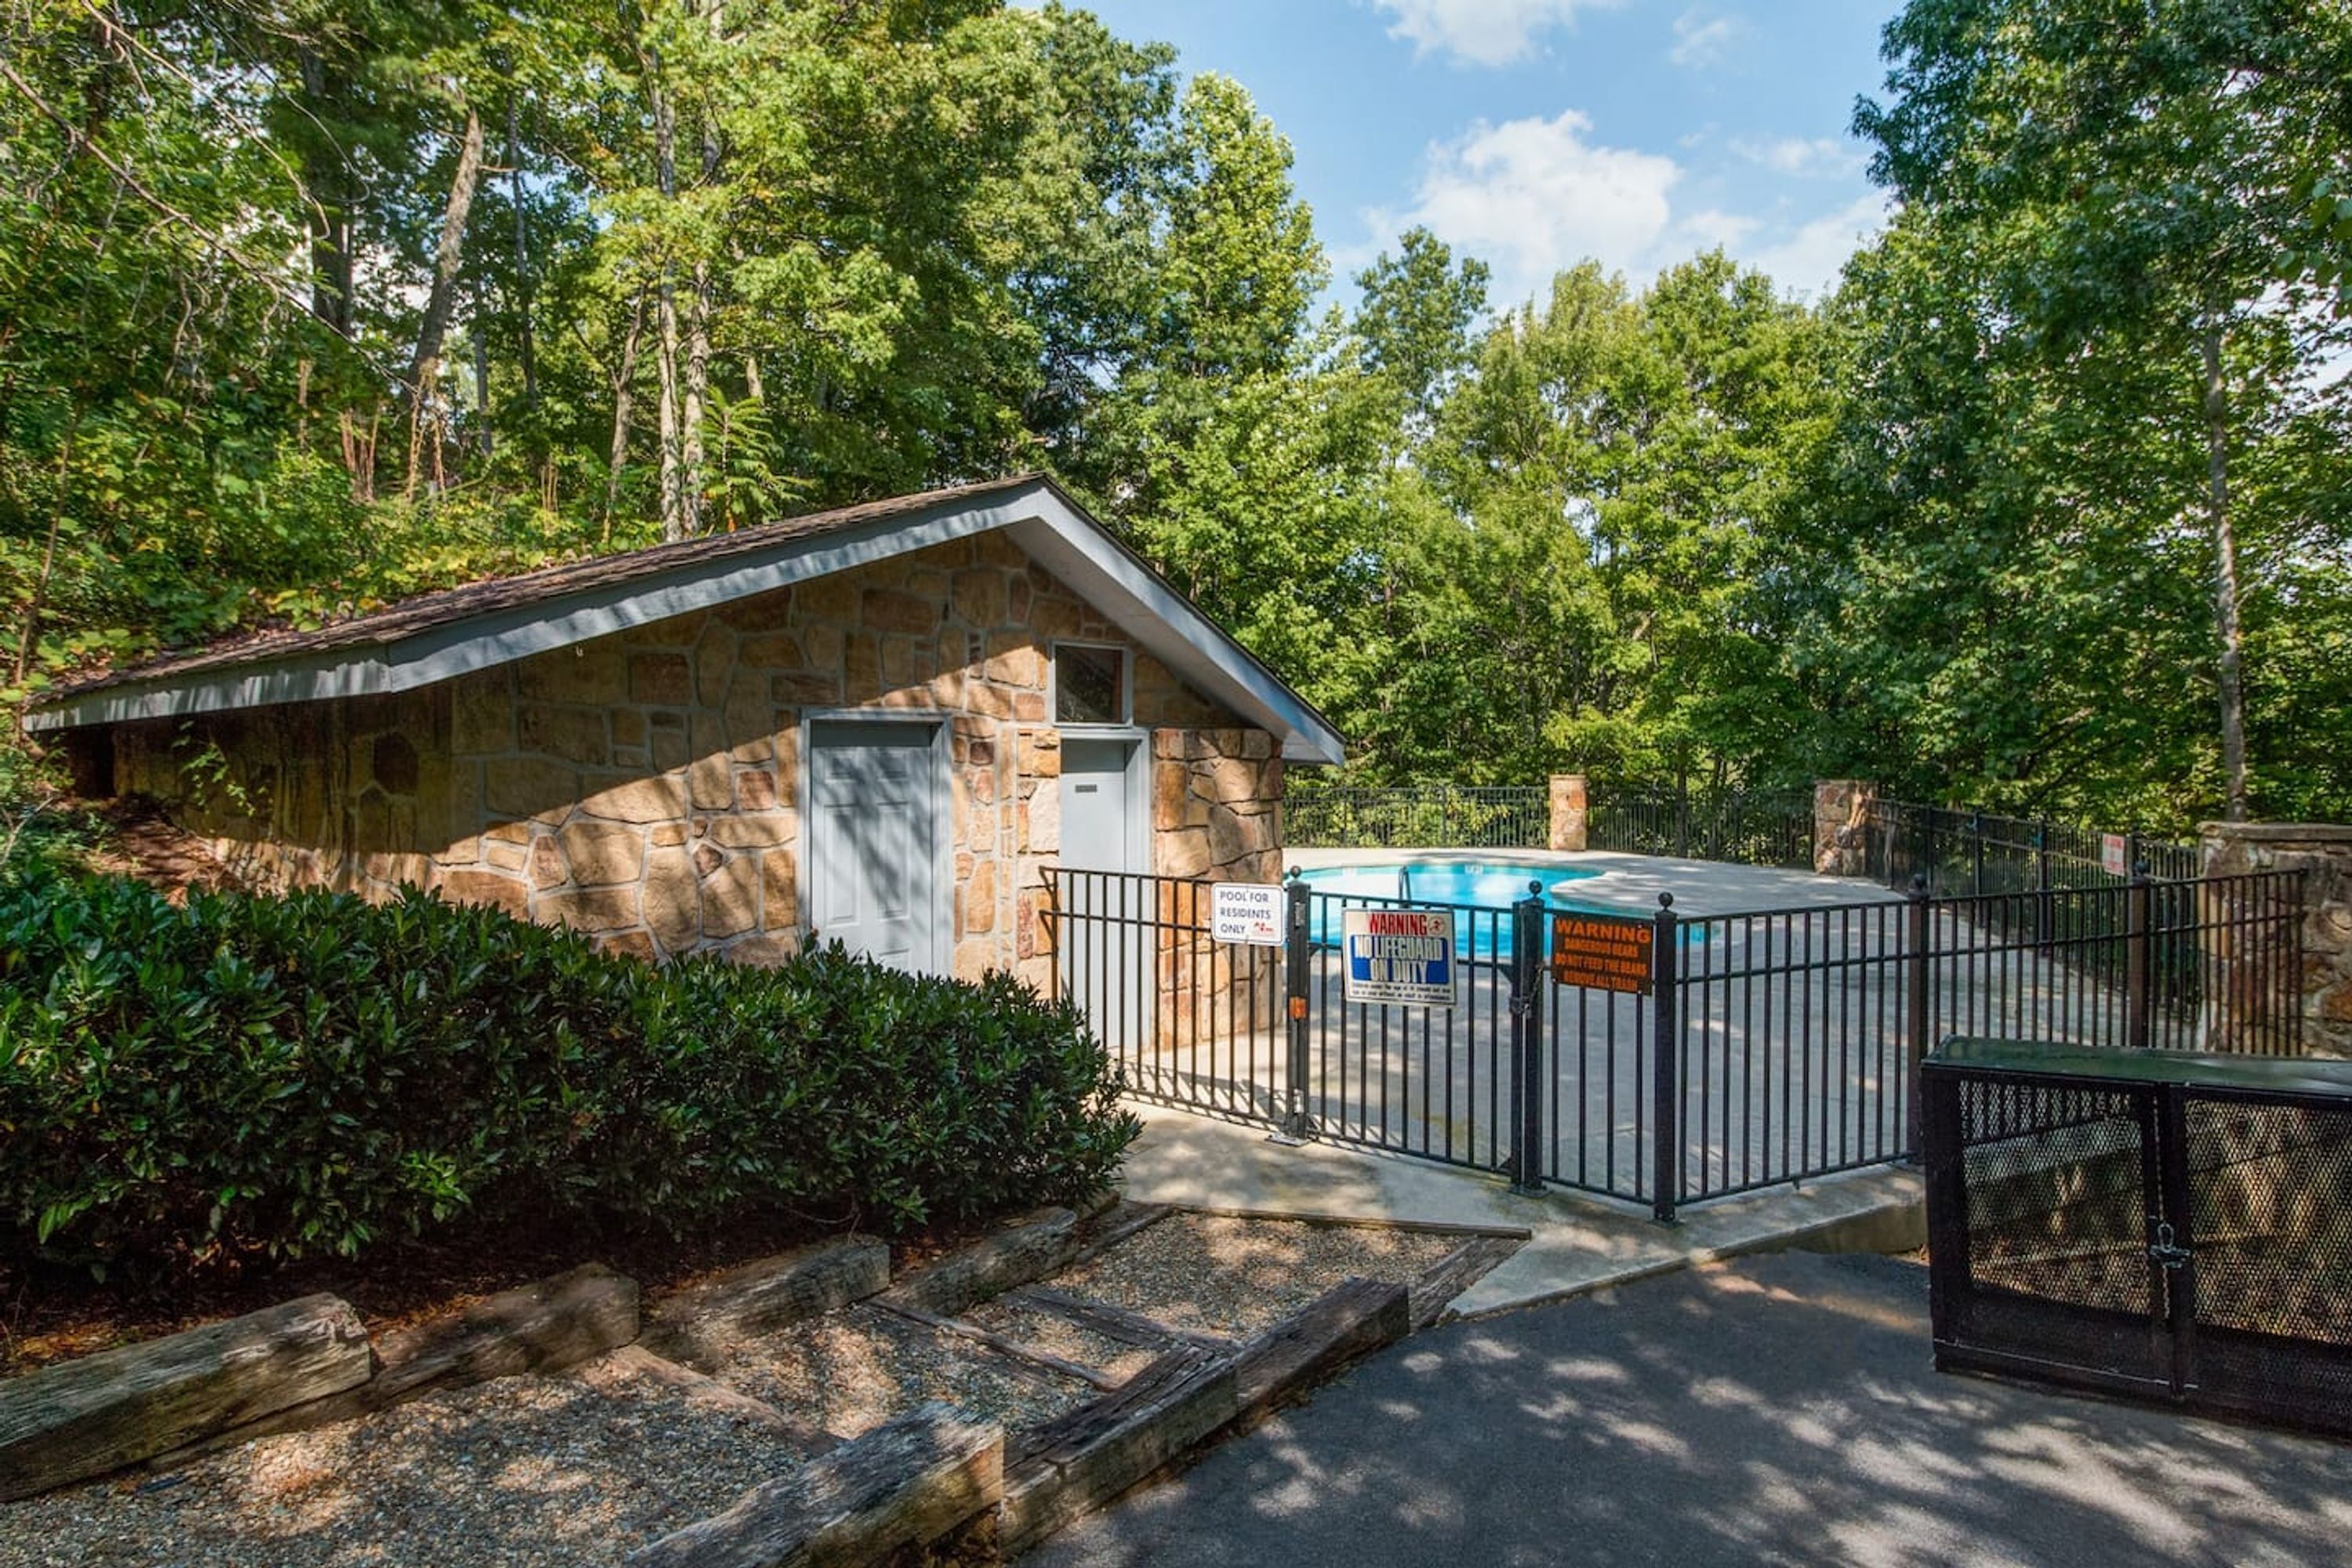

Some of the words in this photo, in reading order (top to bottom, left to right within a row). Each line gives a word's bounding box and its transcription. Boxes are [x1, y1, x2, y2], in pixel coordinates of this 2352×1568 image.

[1220, 891, 1247, 902] POOL
[1250, 893, 1269, 902] FOR
[1220, 907, 1271, 920] RESIDENTS
[1370, 913, 1428, 936] WARNING
[1220, 924, 1246, 935] ONLY
[1555, 919, 1651, 944] WARNING
[1354, 936, 1370, 958] NO
[1374, 937, 1443, 961] LIFEGUARD
[1370, 958, 1388, 982] ON
[1392, 960, 1428, 984] DUTY
